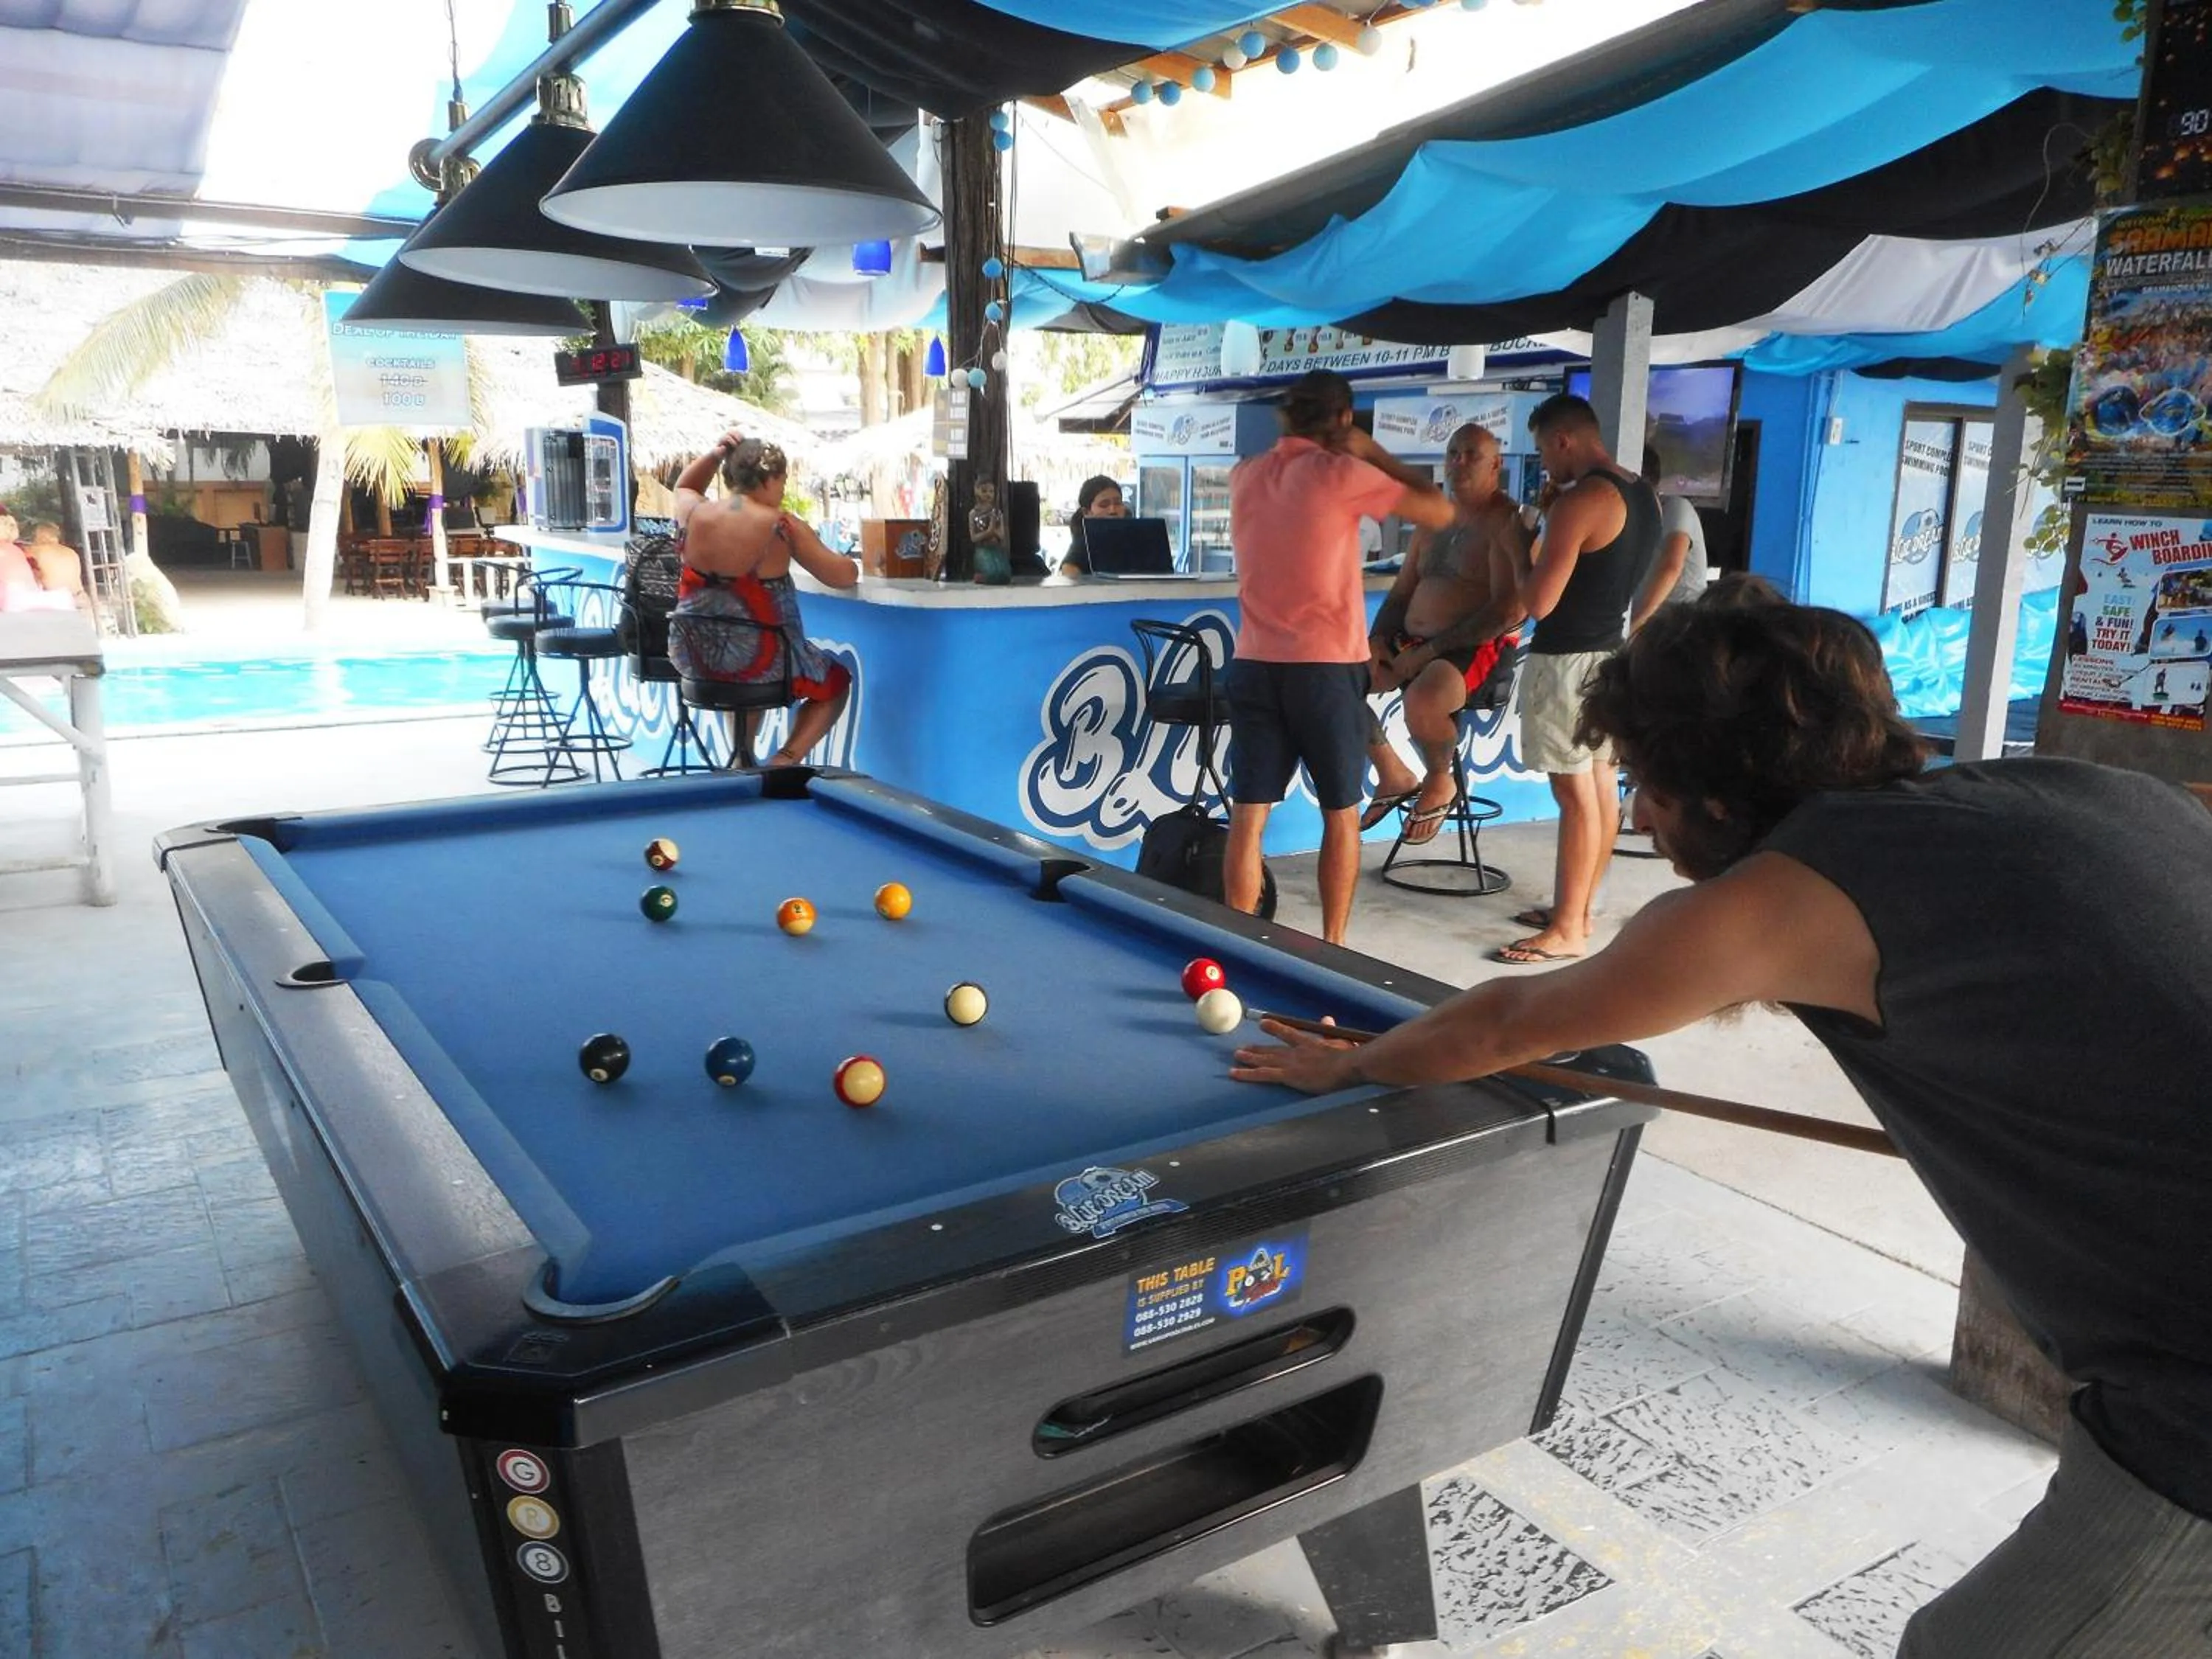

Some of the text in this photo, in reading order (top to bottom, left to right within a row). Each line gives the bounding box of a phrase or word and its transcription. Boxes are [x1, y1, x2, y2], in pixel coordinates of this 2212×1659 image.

[366, 357, 436, 369] COCKTAILS
[1267, 359, 1301, 373] DAYS
[1303, 352, 1371, 369] BETWEEN
[1374, 347, 1409, 364] 10-11
[1412, 345, 1436, 361] PM
[1155, 366, 1190, 383] HAPPY
[1927, 445, 1952, 462] COMPLE
[2093, 518, 2123, 526] LEARN
[2129, 529, 2181, 551] WINCH
[2101, 605, 2131, 616] SAFE
[2095, 616, 2135, 630] & FUN!
[2096, 627, 2131, 640] TRY IT
[2091, 639, 2132, 653] TODAY!
[1136, 1256, 1216, 1293] THIS TABLE
